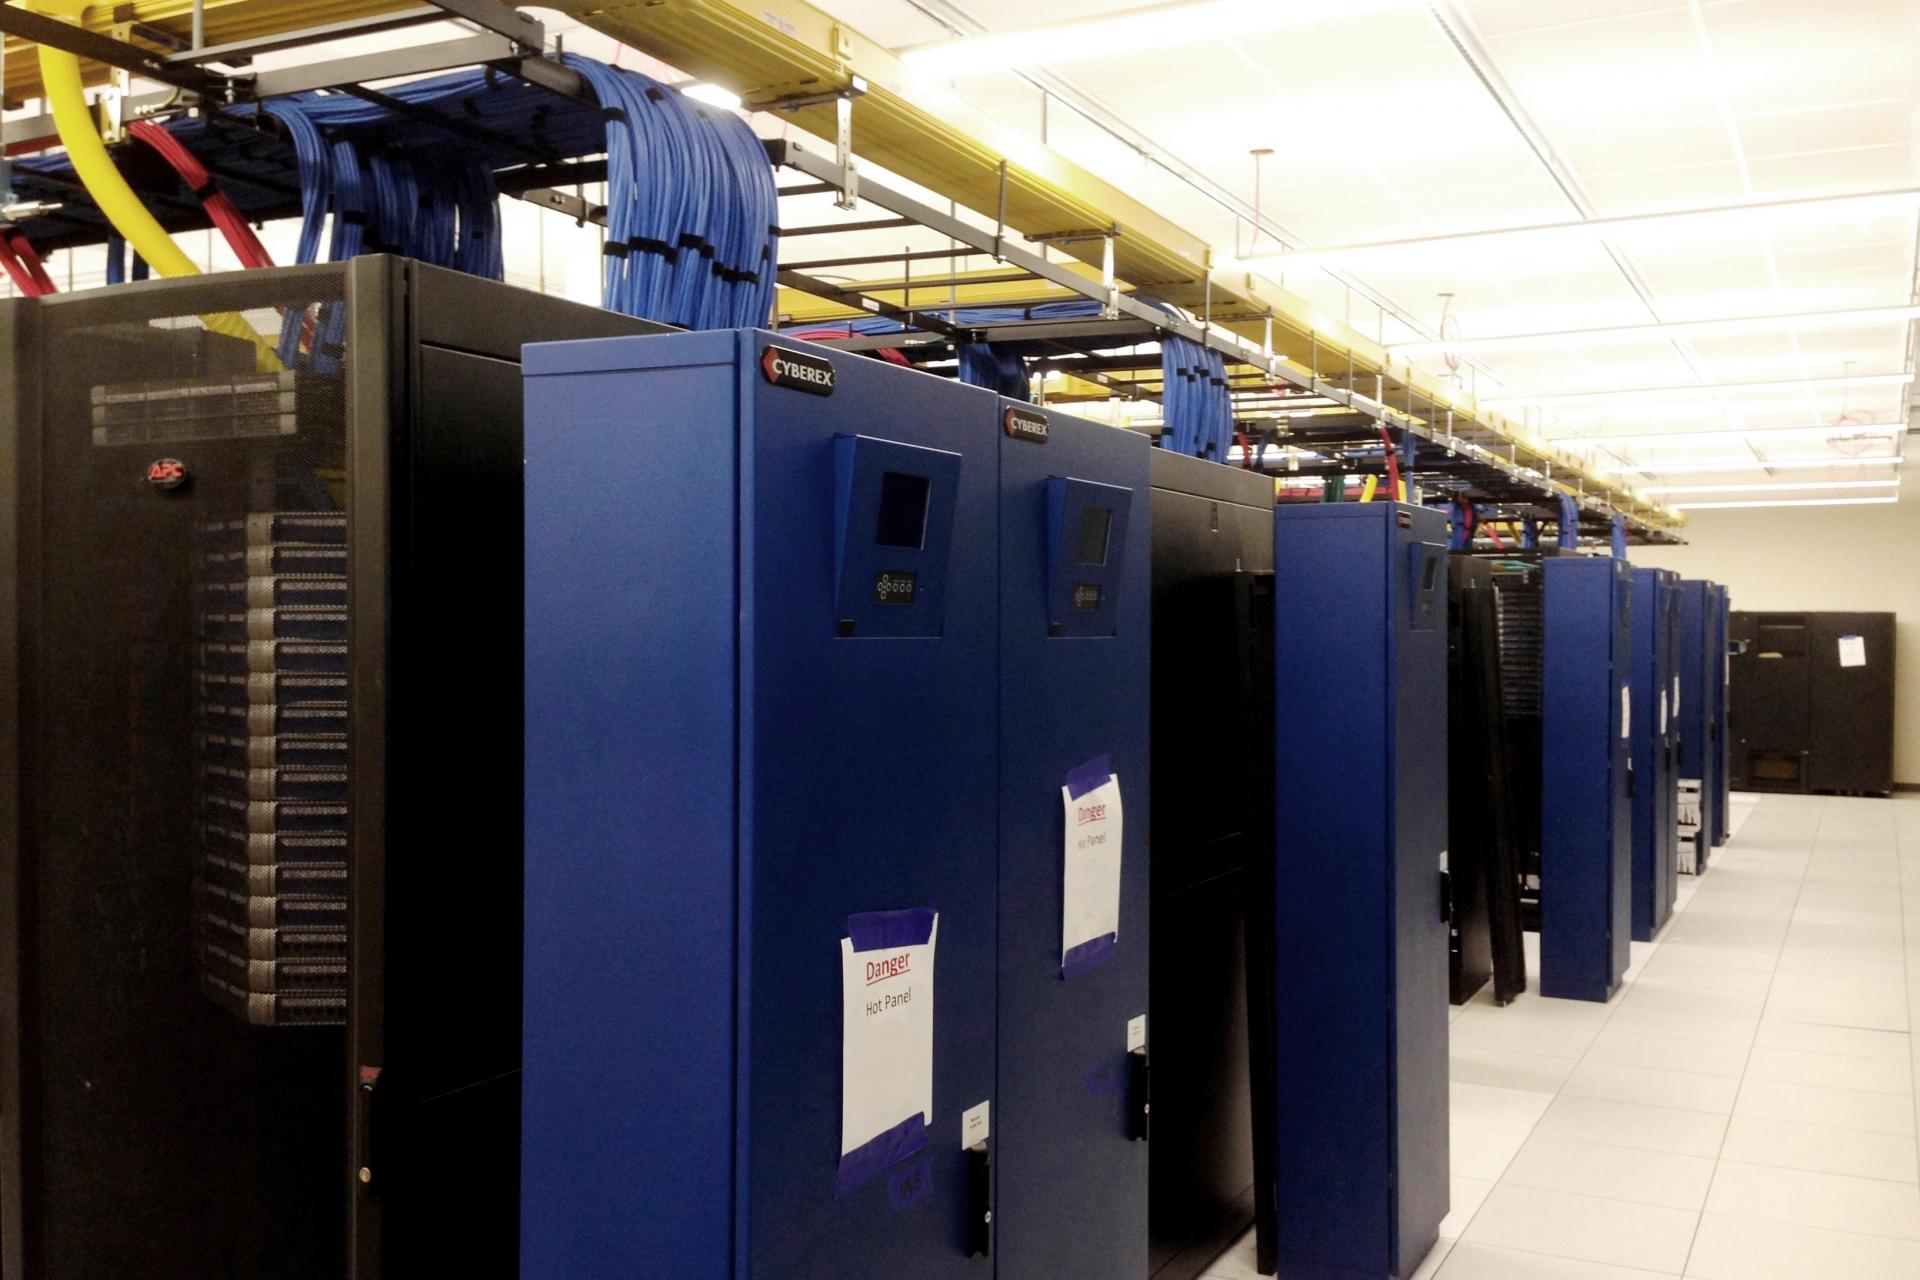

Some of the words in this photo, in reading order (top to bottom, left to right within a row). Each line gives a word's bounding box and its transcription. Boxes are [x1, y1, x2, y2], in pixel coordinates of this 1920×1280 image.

[772, 358, 833, 387] CYBEREX
[1011, 417, 1048, 436] CYBEREX
[149, 463, 183, 479] APC
[866, 953, 910, 981] Danger
[866, 999, 882, 1017] Hot
[885, 986, 911, 1010] Panel
